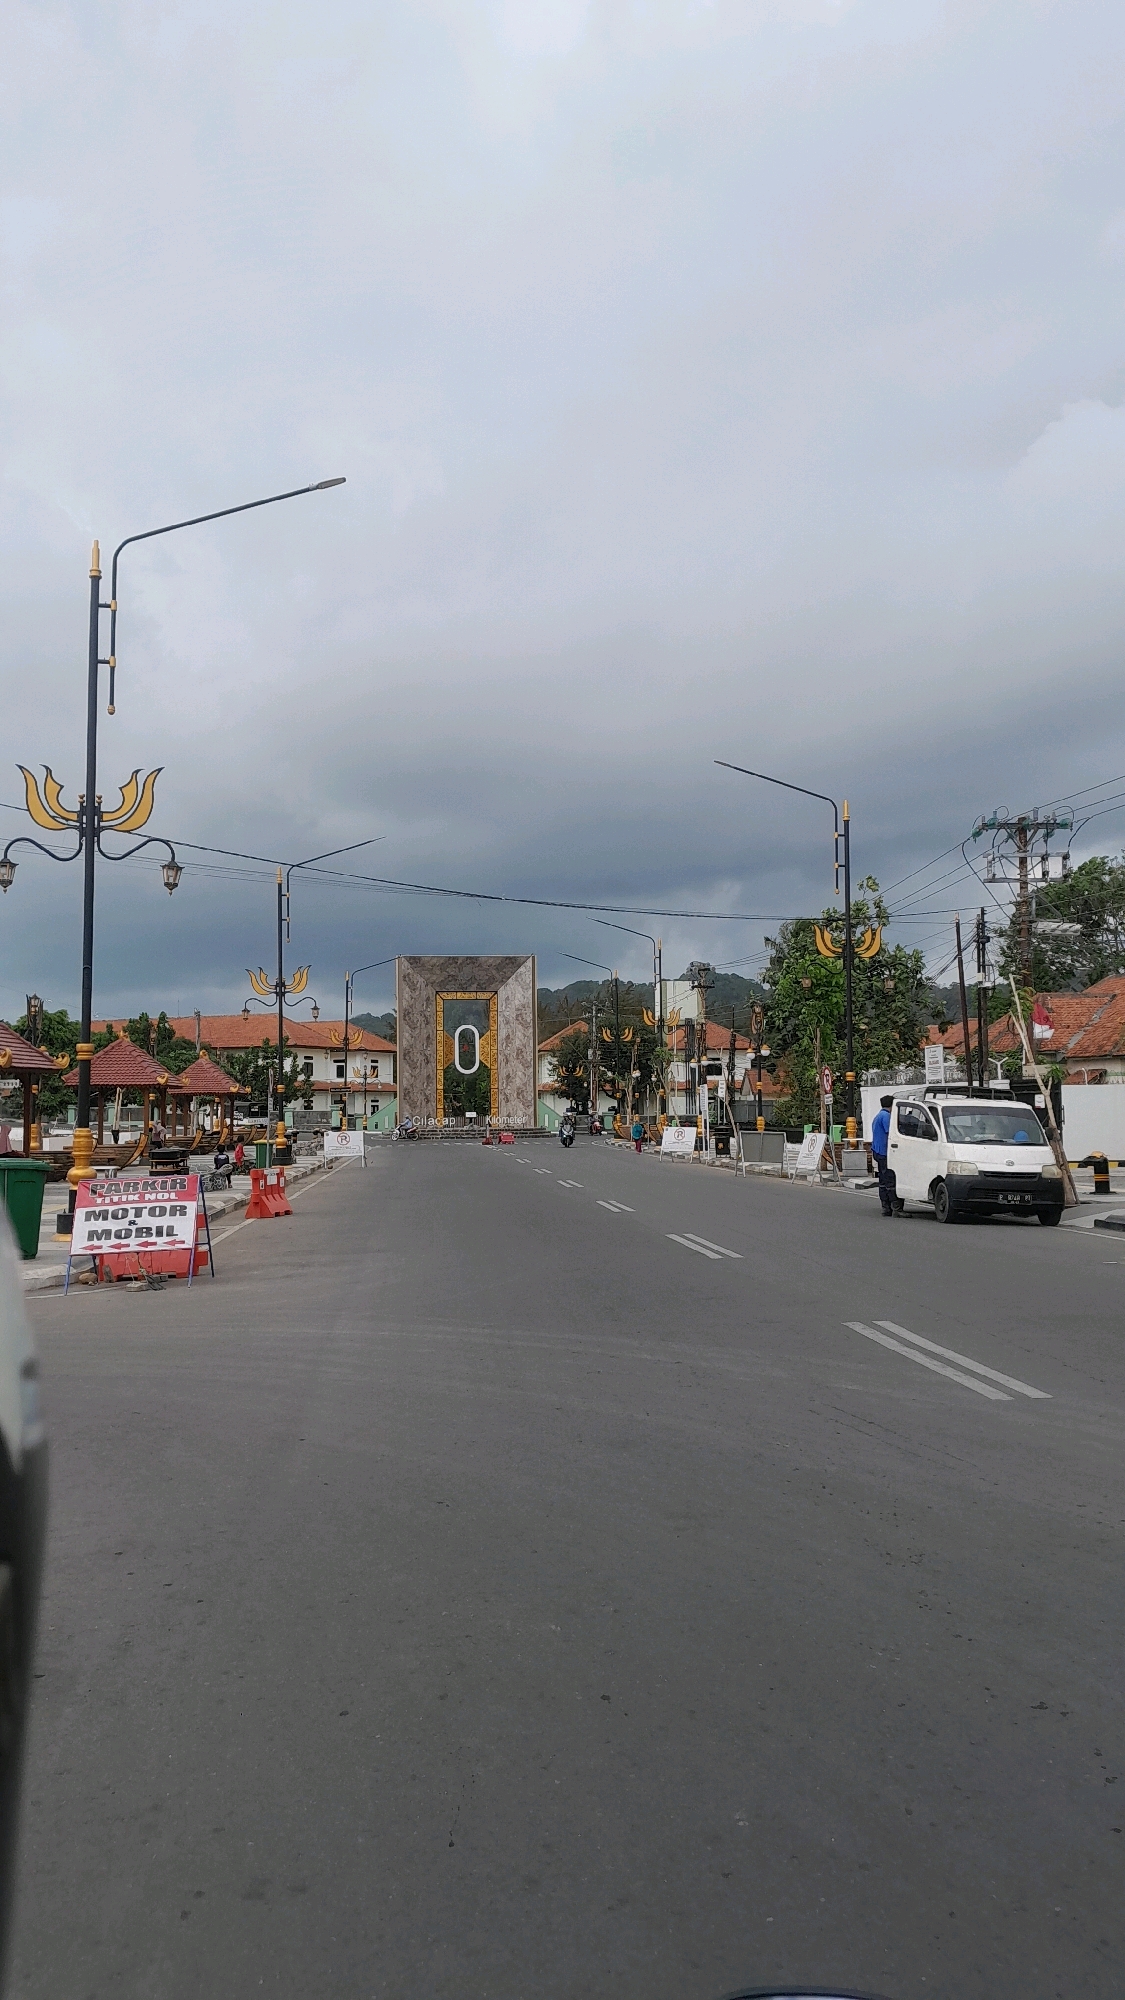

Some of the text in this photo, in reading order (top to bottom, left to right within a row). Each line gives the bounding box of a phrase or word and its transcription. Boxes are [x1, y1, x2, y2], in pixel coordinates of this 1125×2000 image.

[412, 1115, 456, 1128] Cilacap
[485, 1114, 528, 1125] Kilometer
[89, 1177, 188, 1198] PARKIR
[94, 1192, 178, 1204] TITIK NOL
[84, 1204, 188, 1222] MOTOR
[86, 1225, 179, 1242] MOBIL
